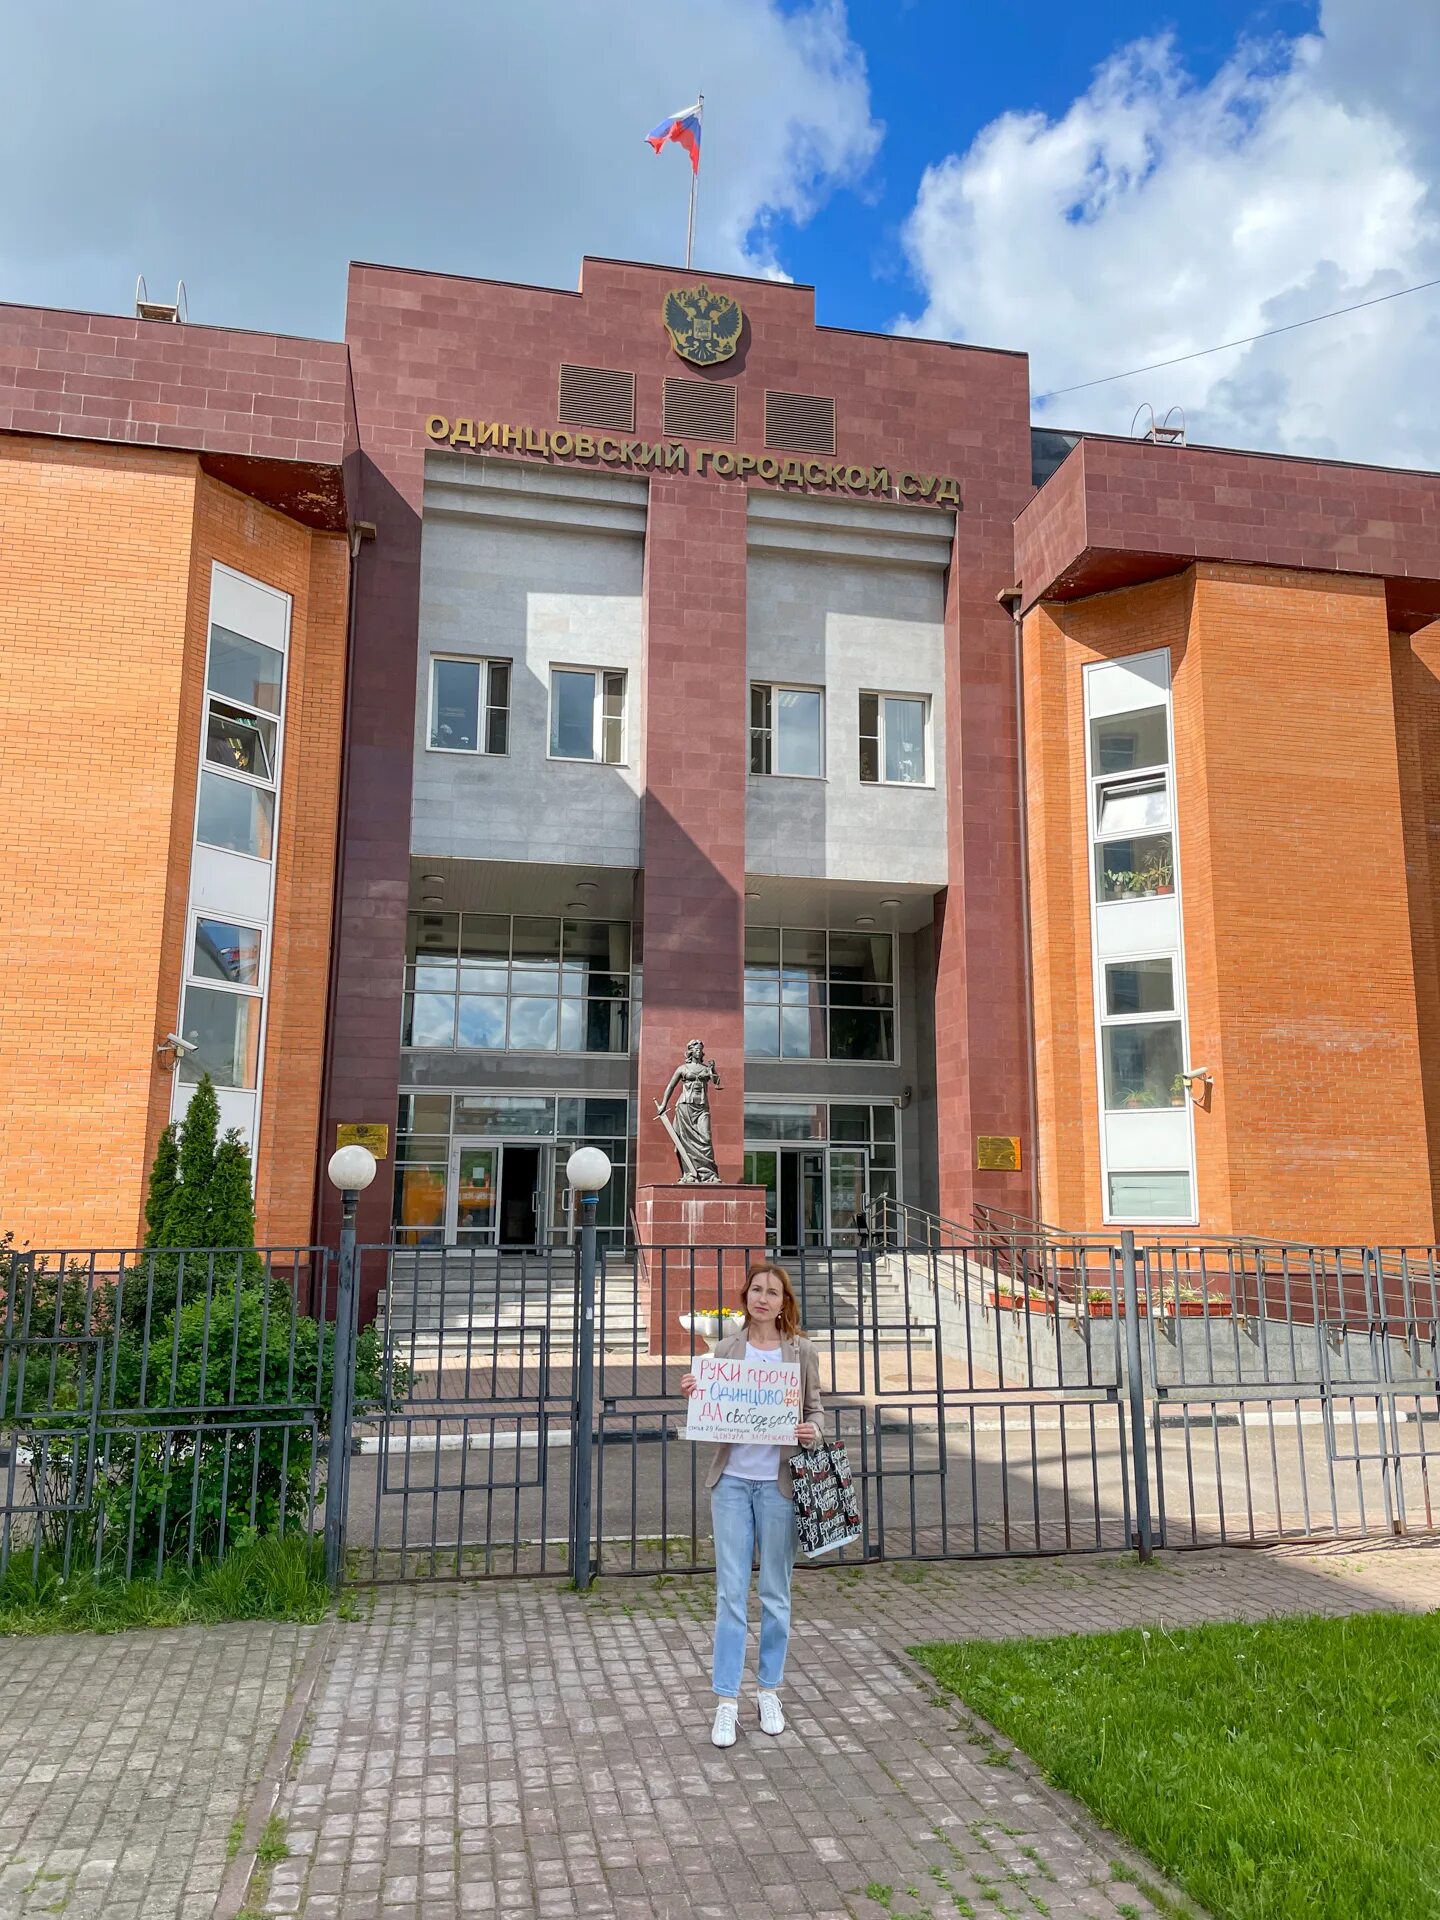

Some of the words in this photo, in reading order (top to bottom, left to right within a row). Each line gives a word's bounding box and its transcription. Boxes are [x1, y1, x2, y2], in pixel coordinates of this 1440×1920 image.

[425, 414, 686, 470] ОДИНЦОВСКИЙ
[695, 446, 890, 492] ГОРОДСКОЙ
[898, 472, 960, 504] СУД
[699, 1402, 722, 1423] ДА
